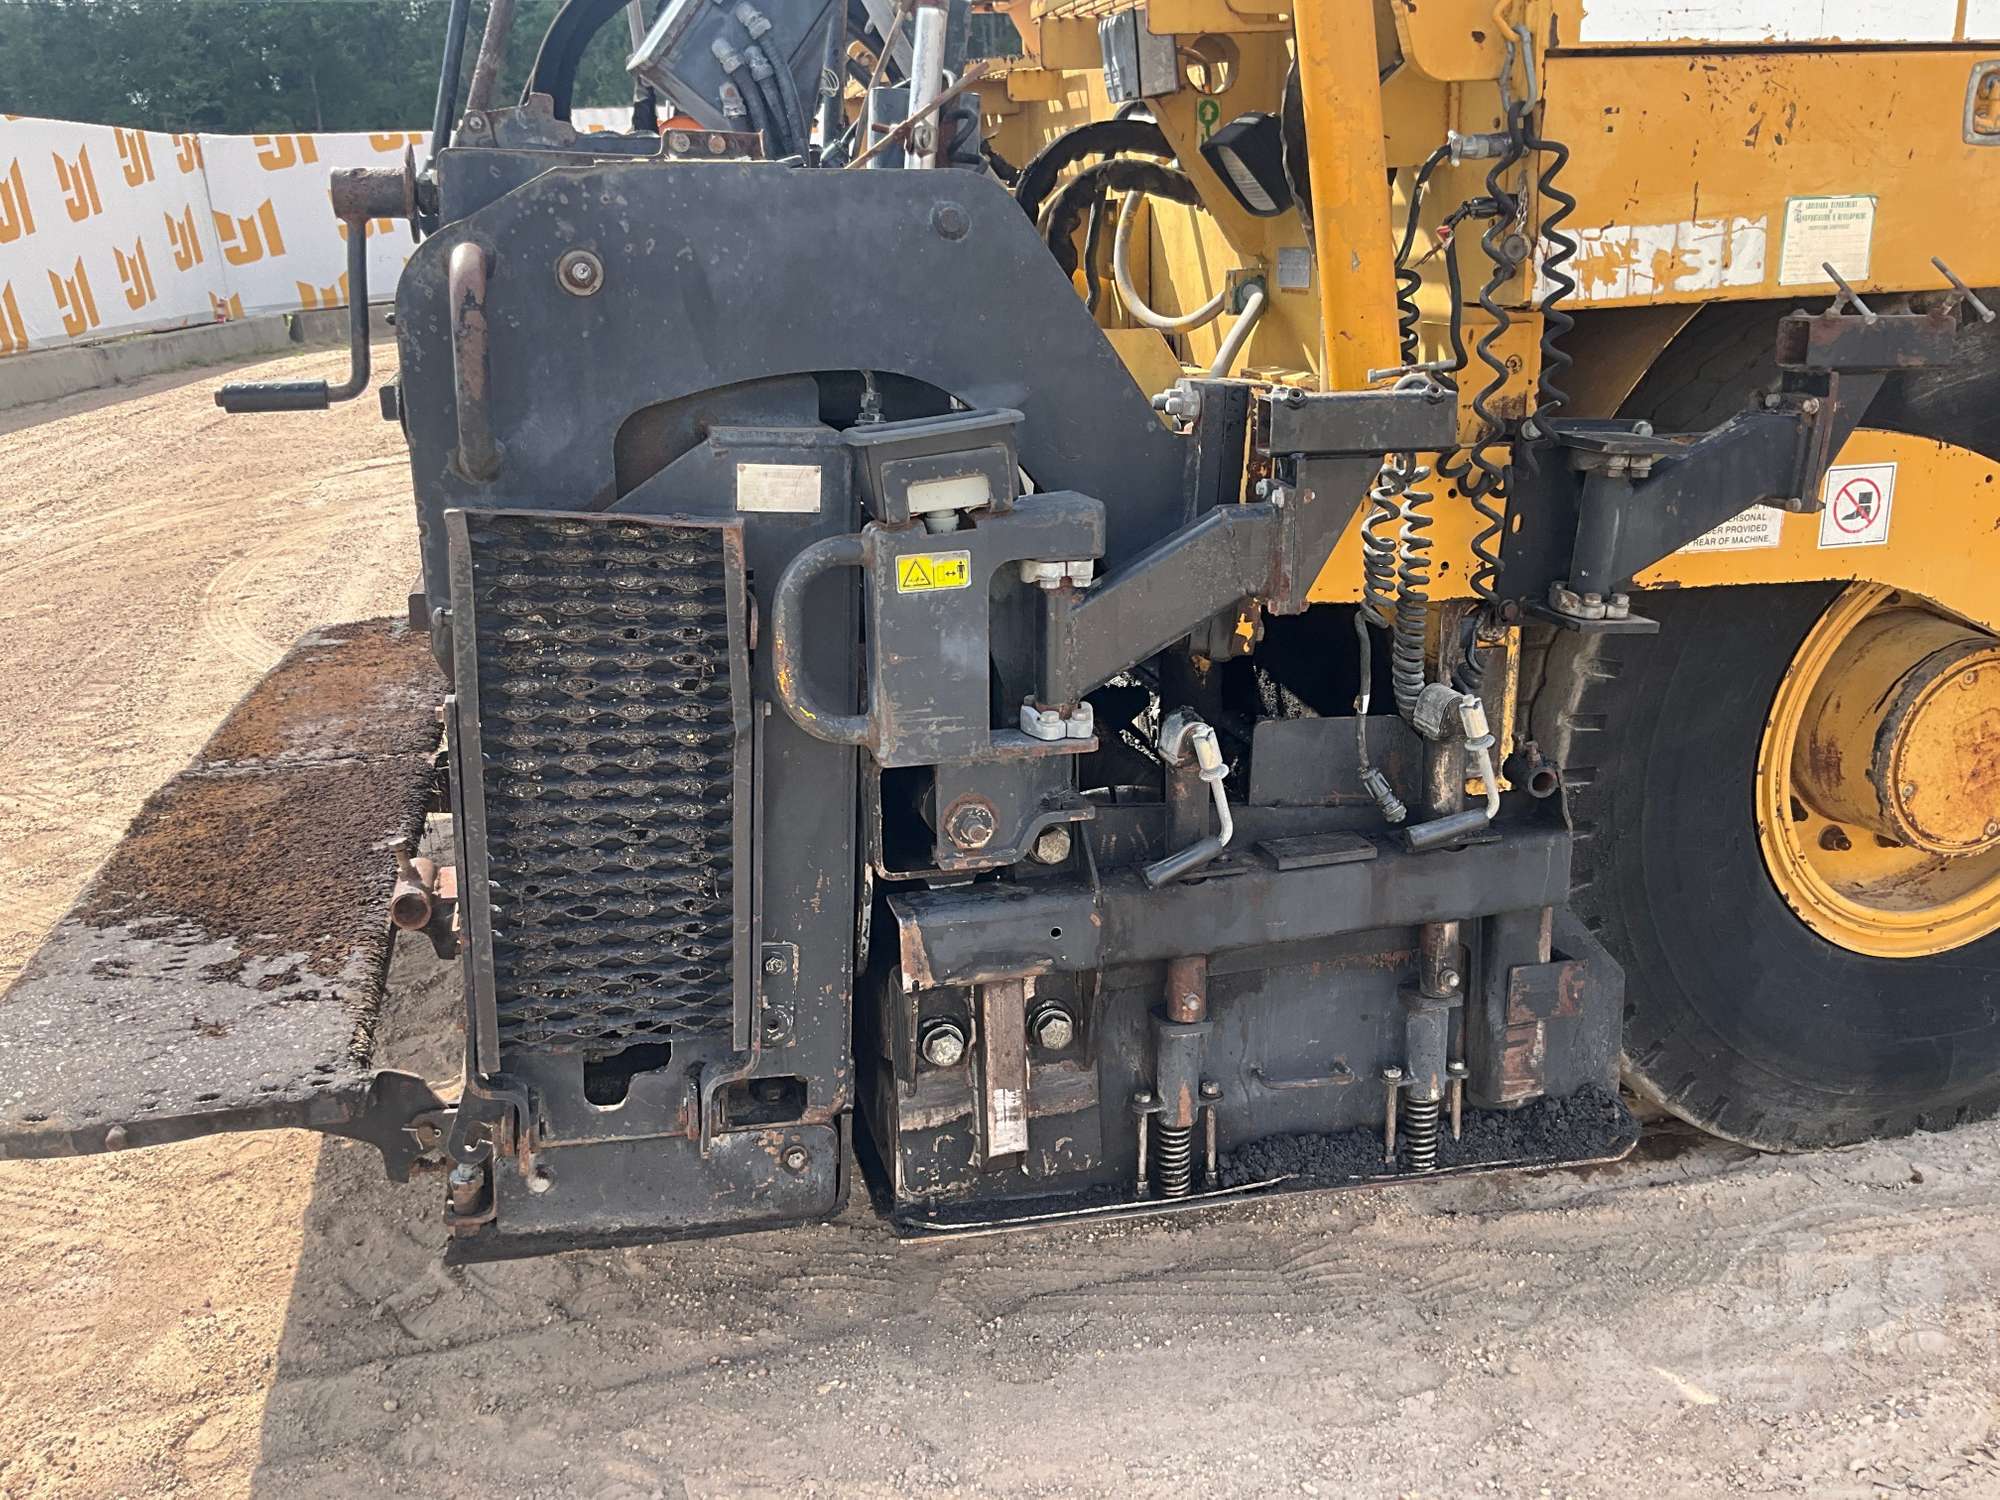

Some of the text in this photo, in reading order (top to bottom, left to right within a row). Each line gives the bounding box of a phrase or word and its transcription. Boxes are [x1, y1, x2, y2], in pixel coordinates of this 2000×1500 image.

[1725, 524, 1768, 534] PROVIDED
[1693, 538, 1716, 546] REAR
[1718, 537, 1730, 545] OF
